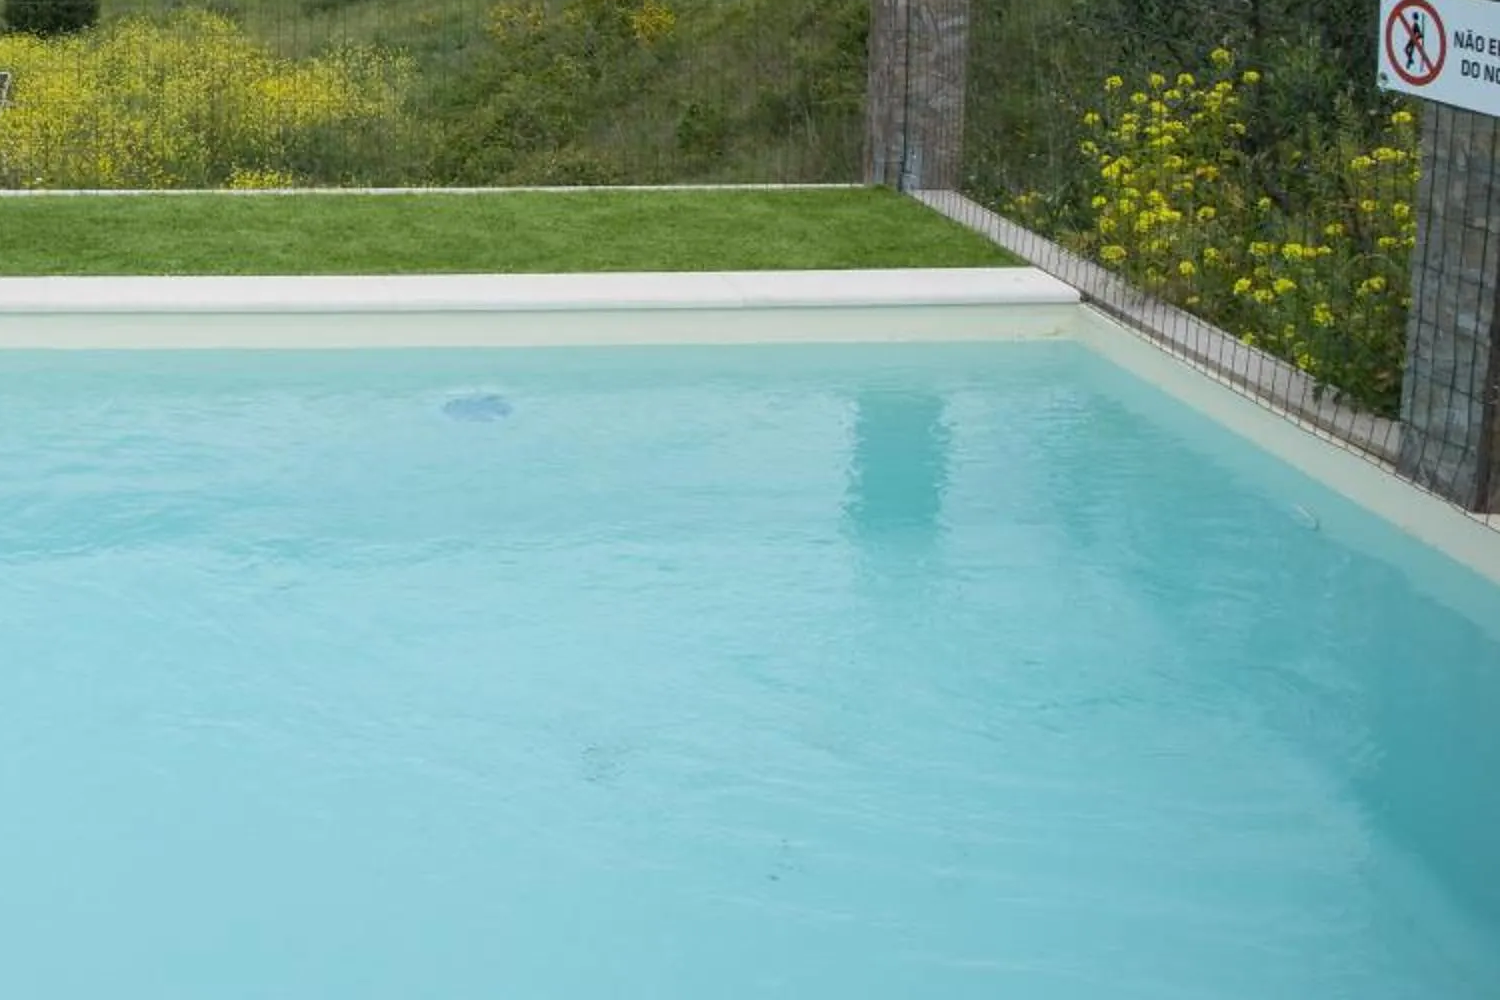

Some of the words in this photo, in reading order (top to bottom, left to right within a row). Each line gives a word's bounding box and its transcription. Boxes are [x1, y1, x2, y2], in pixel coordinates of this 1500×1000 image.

[1453, 29, 1484, 53] NÃO
[1489, 38, 1500, 56] E
[1461, 59, 1480, 78] DO
